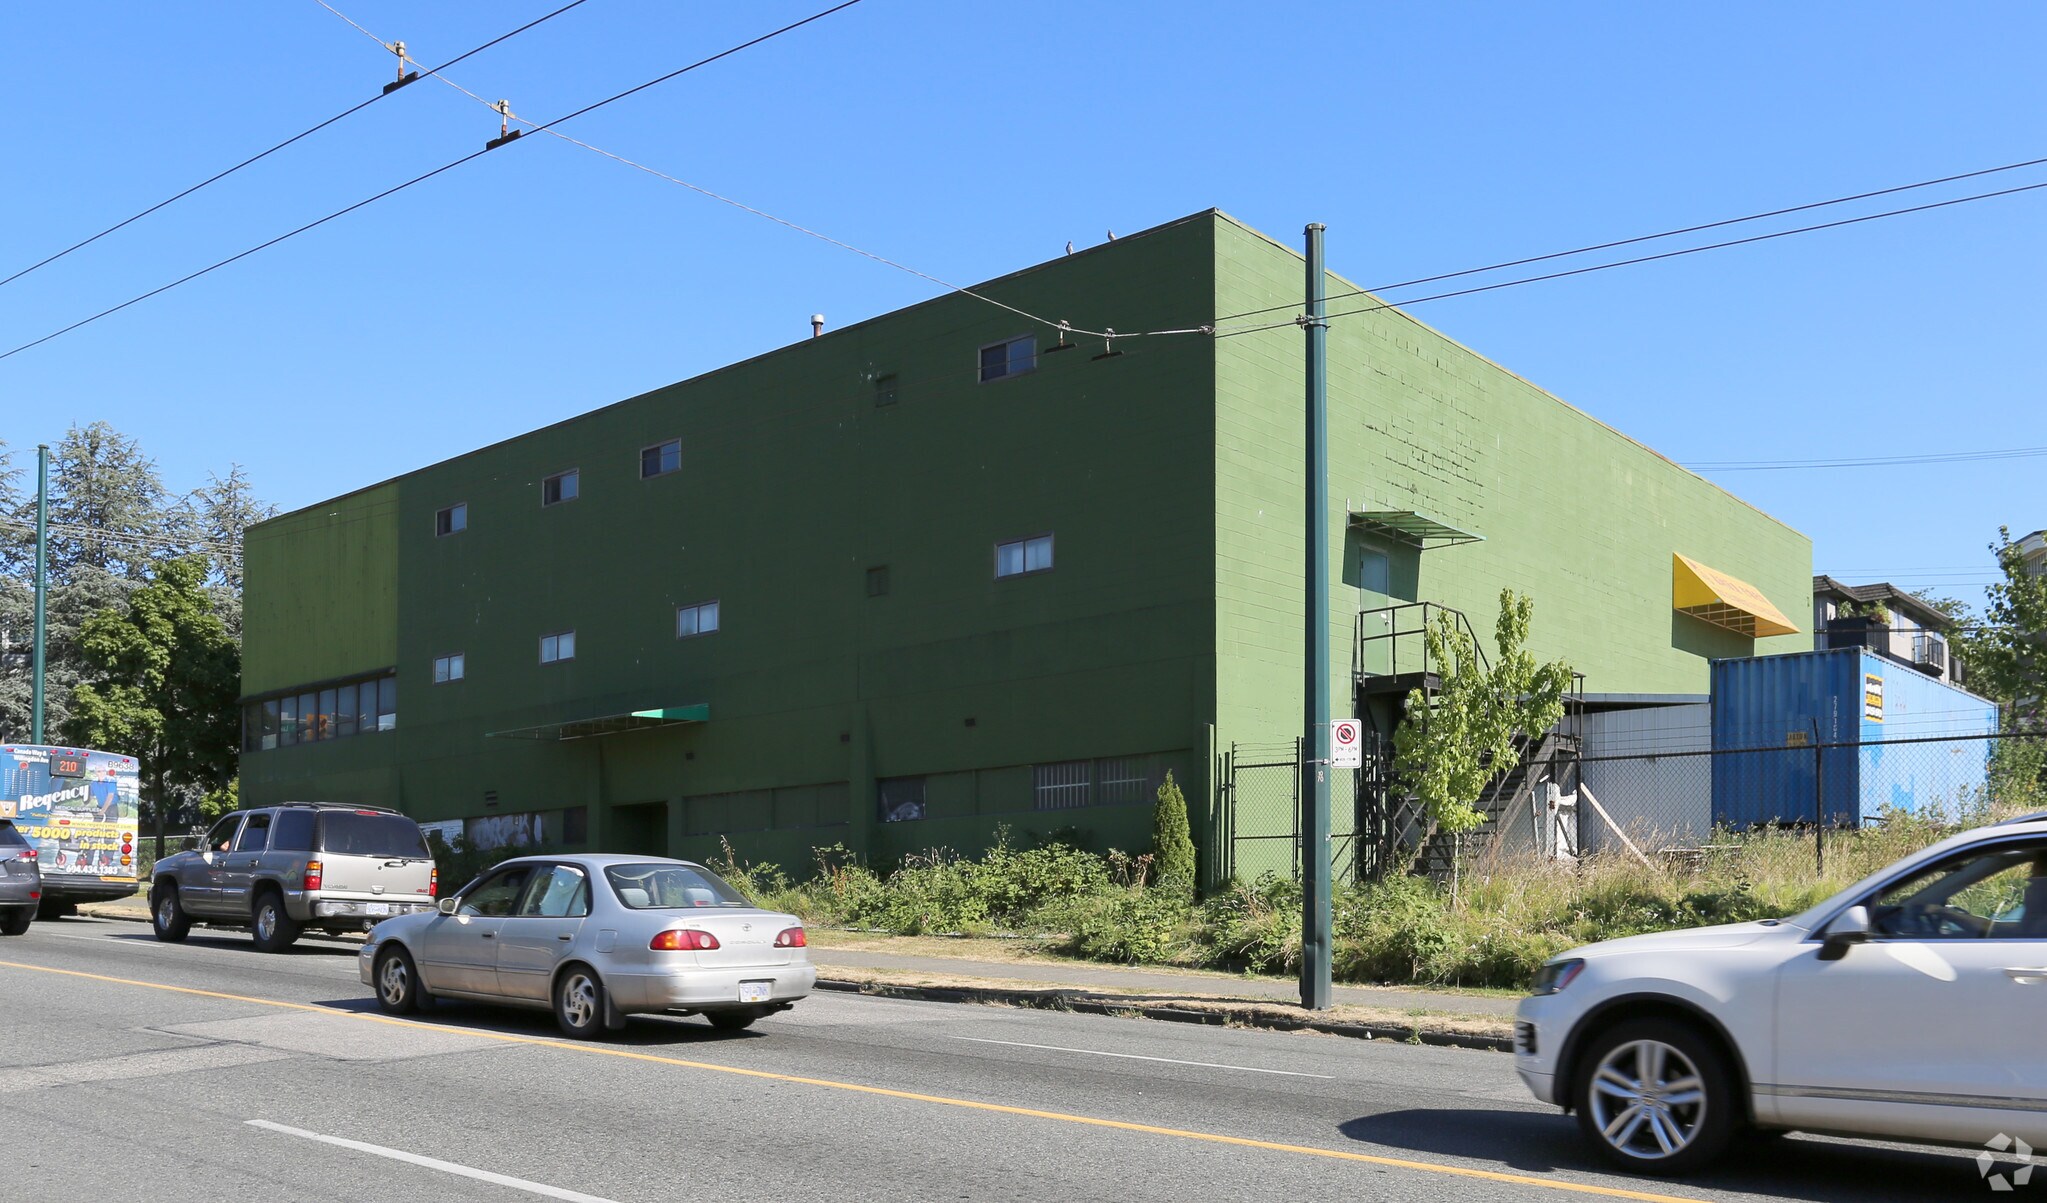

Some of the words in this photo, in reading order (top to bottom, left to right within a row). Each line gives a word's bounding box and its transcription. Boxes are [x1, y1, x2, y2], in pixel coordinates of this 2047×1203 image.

[60, 760, 77, 772] 210
[20, 785, 89, 811] Regency
[31, 826, 71, 840] 5000
[74, 829, 119, 839] products
[79, 840, 89, 849] in
[91, 841, 119, 850] stock
